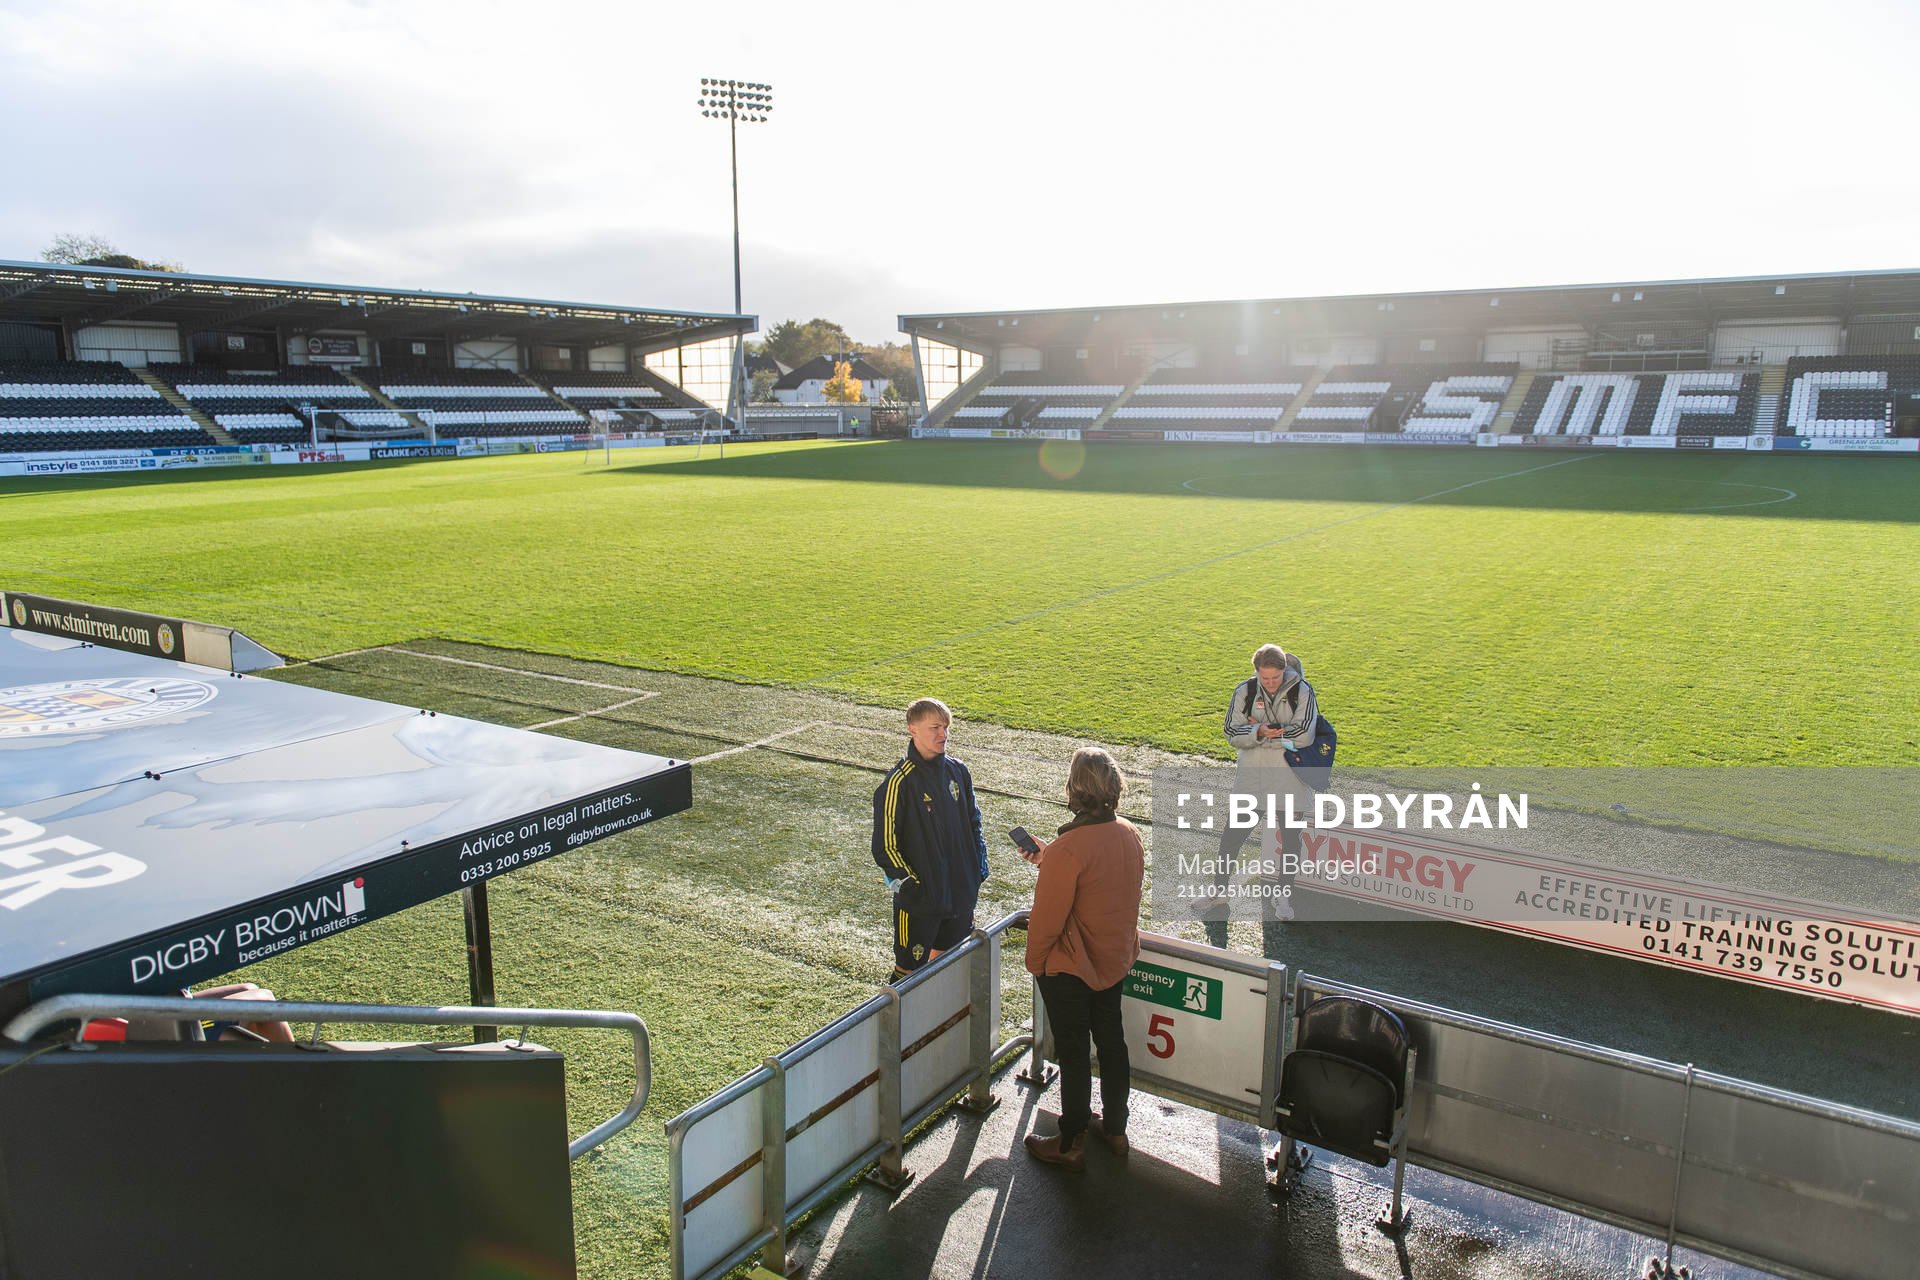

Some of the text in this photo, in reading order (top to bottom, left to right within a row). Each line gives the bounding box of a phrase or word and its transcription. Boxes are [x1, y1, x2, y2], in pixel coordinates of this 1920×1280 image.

[27, 461, 78, 473] instyle
[80, 459, 100, 467] 0141
[377, 449, 410, 458] CLARKE
[32, 608, 150, 646] www.stmirren.com
[459, 791, 642, 860] Advice on legal matters...
[461, 808, 652, 882] 0333 200 5925 digbybrown.co.uk
[1275, 831, 1476, 893] YNERGY
[1340, 873, 1474, 912] SOLUTIONS LTD
[1539, 874, 1673, 914] EFFECTIVE
[1683, 901, 1793, 936] LIFTING
[130, 891, 342, 984] DIGBY BROWN
[238, 912, 367, 964] because it matters...
[1515, 890, 1671, 933] ACCREDITED
[1682, 921, 1818, 961] TRAINING
[1643, 935, 1842, 987] 0141 739 7550
[1133, 982, 1153, 995] exit
[1147, 1013, 1175, 1059] 5
